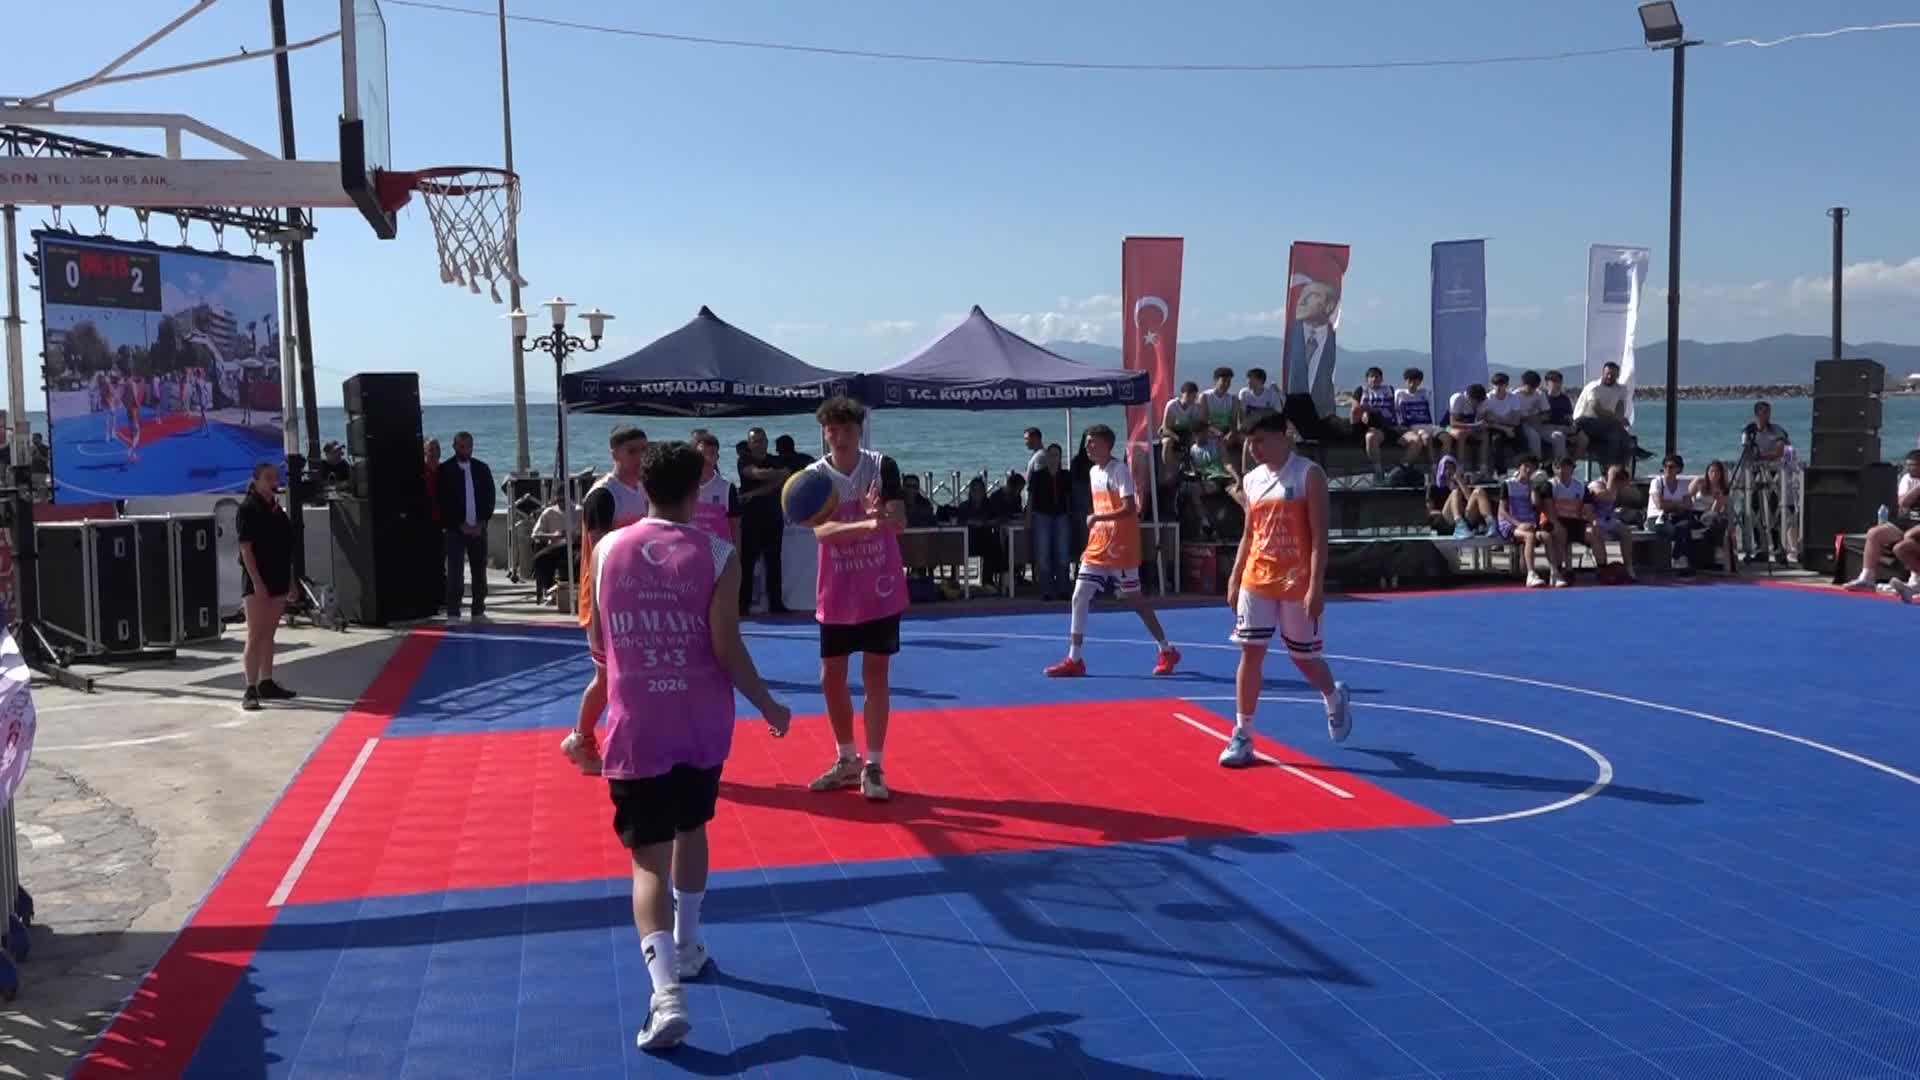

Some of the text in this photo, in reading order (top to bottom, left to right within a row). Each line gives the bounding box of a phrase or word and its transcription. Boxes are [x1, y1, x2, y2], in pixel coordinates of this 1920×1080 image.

[65, 260, 80, 288] 0
[130, 267, 144, 293] 2
[641, 381, 725, 396] KUŞADASI
[907, 388, 937, 400] T.C.
[940, 387, 1018, 403] KUŞADASI
[647, 679, 687, 692] 2026
